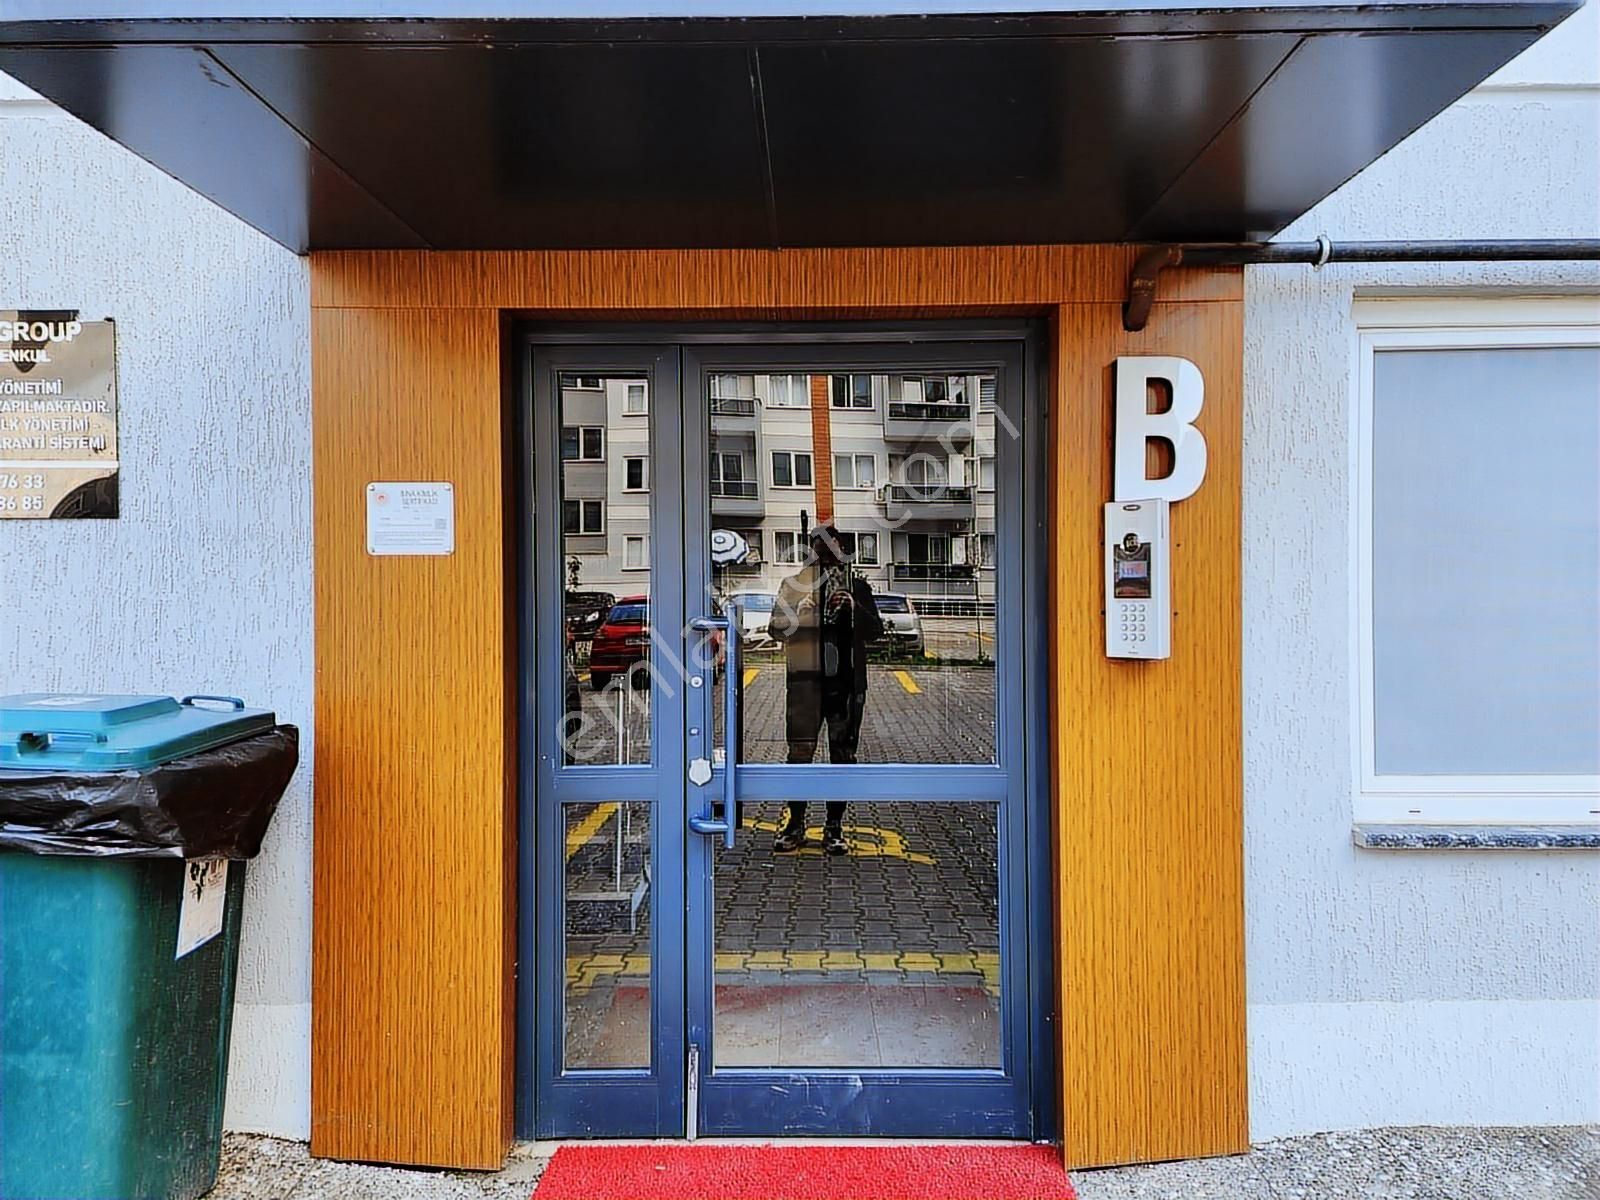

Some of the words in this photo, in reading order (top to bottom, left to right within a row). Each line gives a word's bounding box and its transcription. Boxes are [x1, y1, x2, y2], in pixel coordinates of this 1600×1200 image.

[0, 321, 82, 342] GROUP
[0, 400, 110, 413] APILMAKTADIR.
[1115, 356, 1208, 503] B
[0, 434, 46, 449] RANTİ
